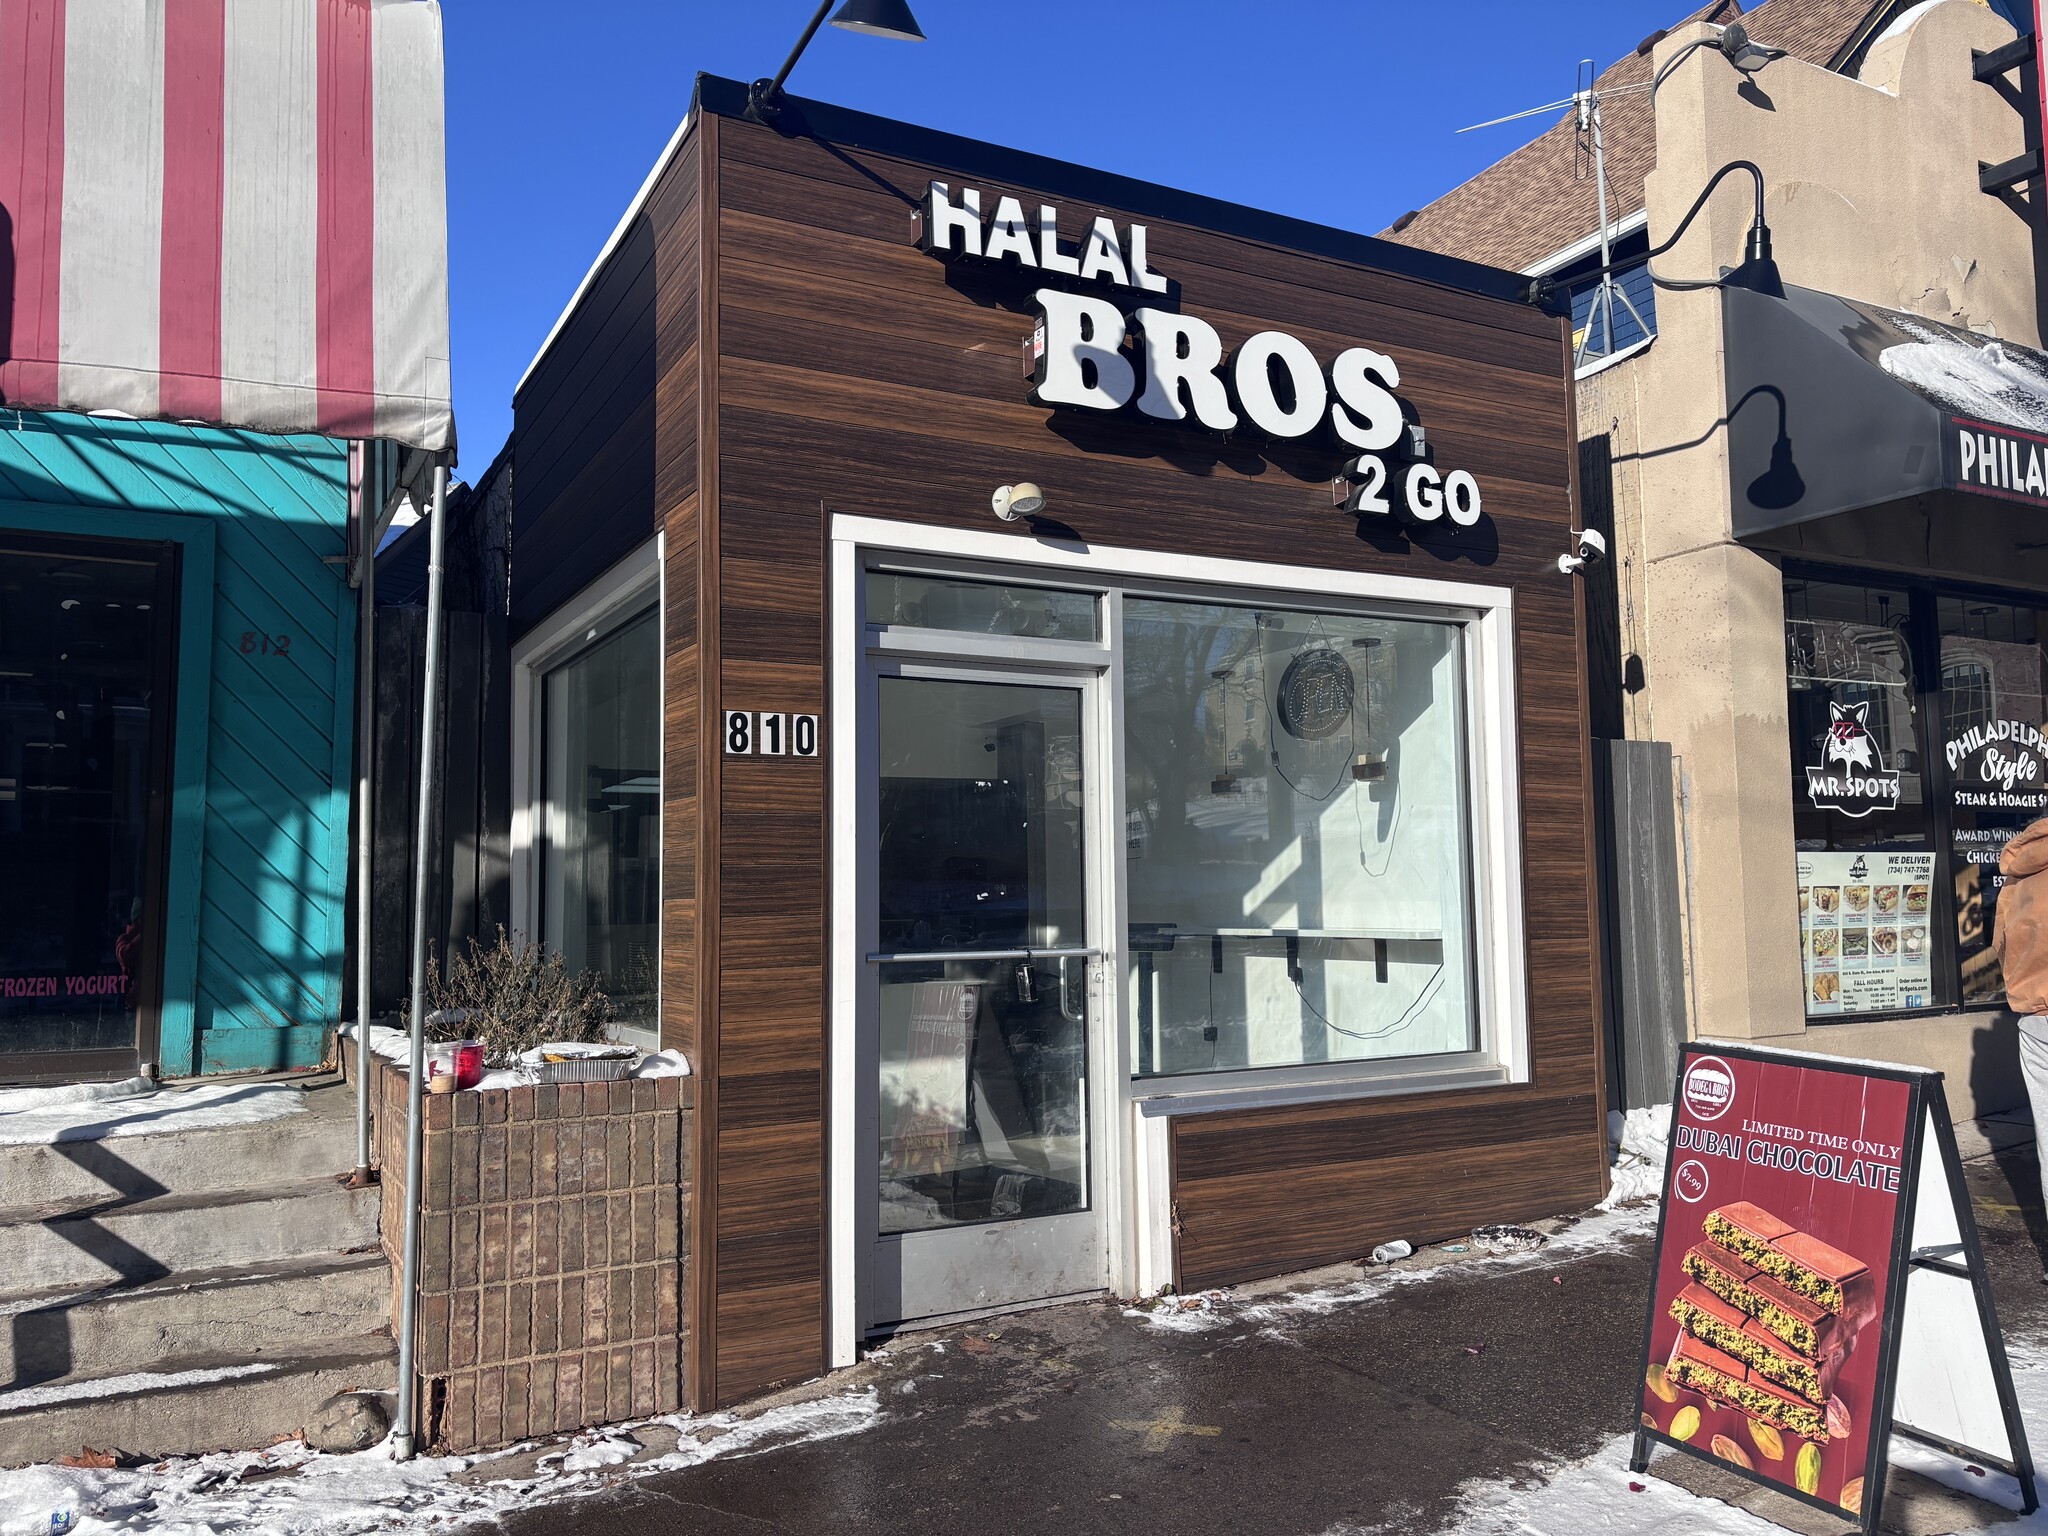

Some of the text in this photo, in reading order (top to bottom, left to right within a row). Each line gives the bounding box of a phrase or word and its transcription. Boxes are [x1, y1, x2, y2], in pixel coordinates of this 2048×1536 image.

[929, 180, 1167, 293] HALAL
[1035, 288, 1403, 450] BROS
[1357, 454, 1481, 526] 2 GO
[240, 631, 291, 656] 812
[1289, 668, 1345, 721] OPEN
[728, 711, 815, 755] 810
[1980, 748, 2039, 791] Style
[1955, 790, 1987, 806] STEAK
[1988, 791, 1998, 806] &
[1999, 792, 2037, 807] HOAGIE
[1955, 828, 1991, 842] AWARD
[1887, 867, 1903, 875] (734)
[1888, 856, 1931, 865] WE DELIVER
[65, 974, 129, 996] YOGURT
[1853, 978, 1884, 987] FALL HOURS
[1688, 1079, 1730, 1098] BODEGA BROS
[1742, 1119, 1901, 1160] LIMITED TIME ONLY
[1676, 1125, 1901, 1194] DUBAI CHOCOLATE
[1681, 1168, 1702, 1191] $7.99
